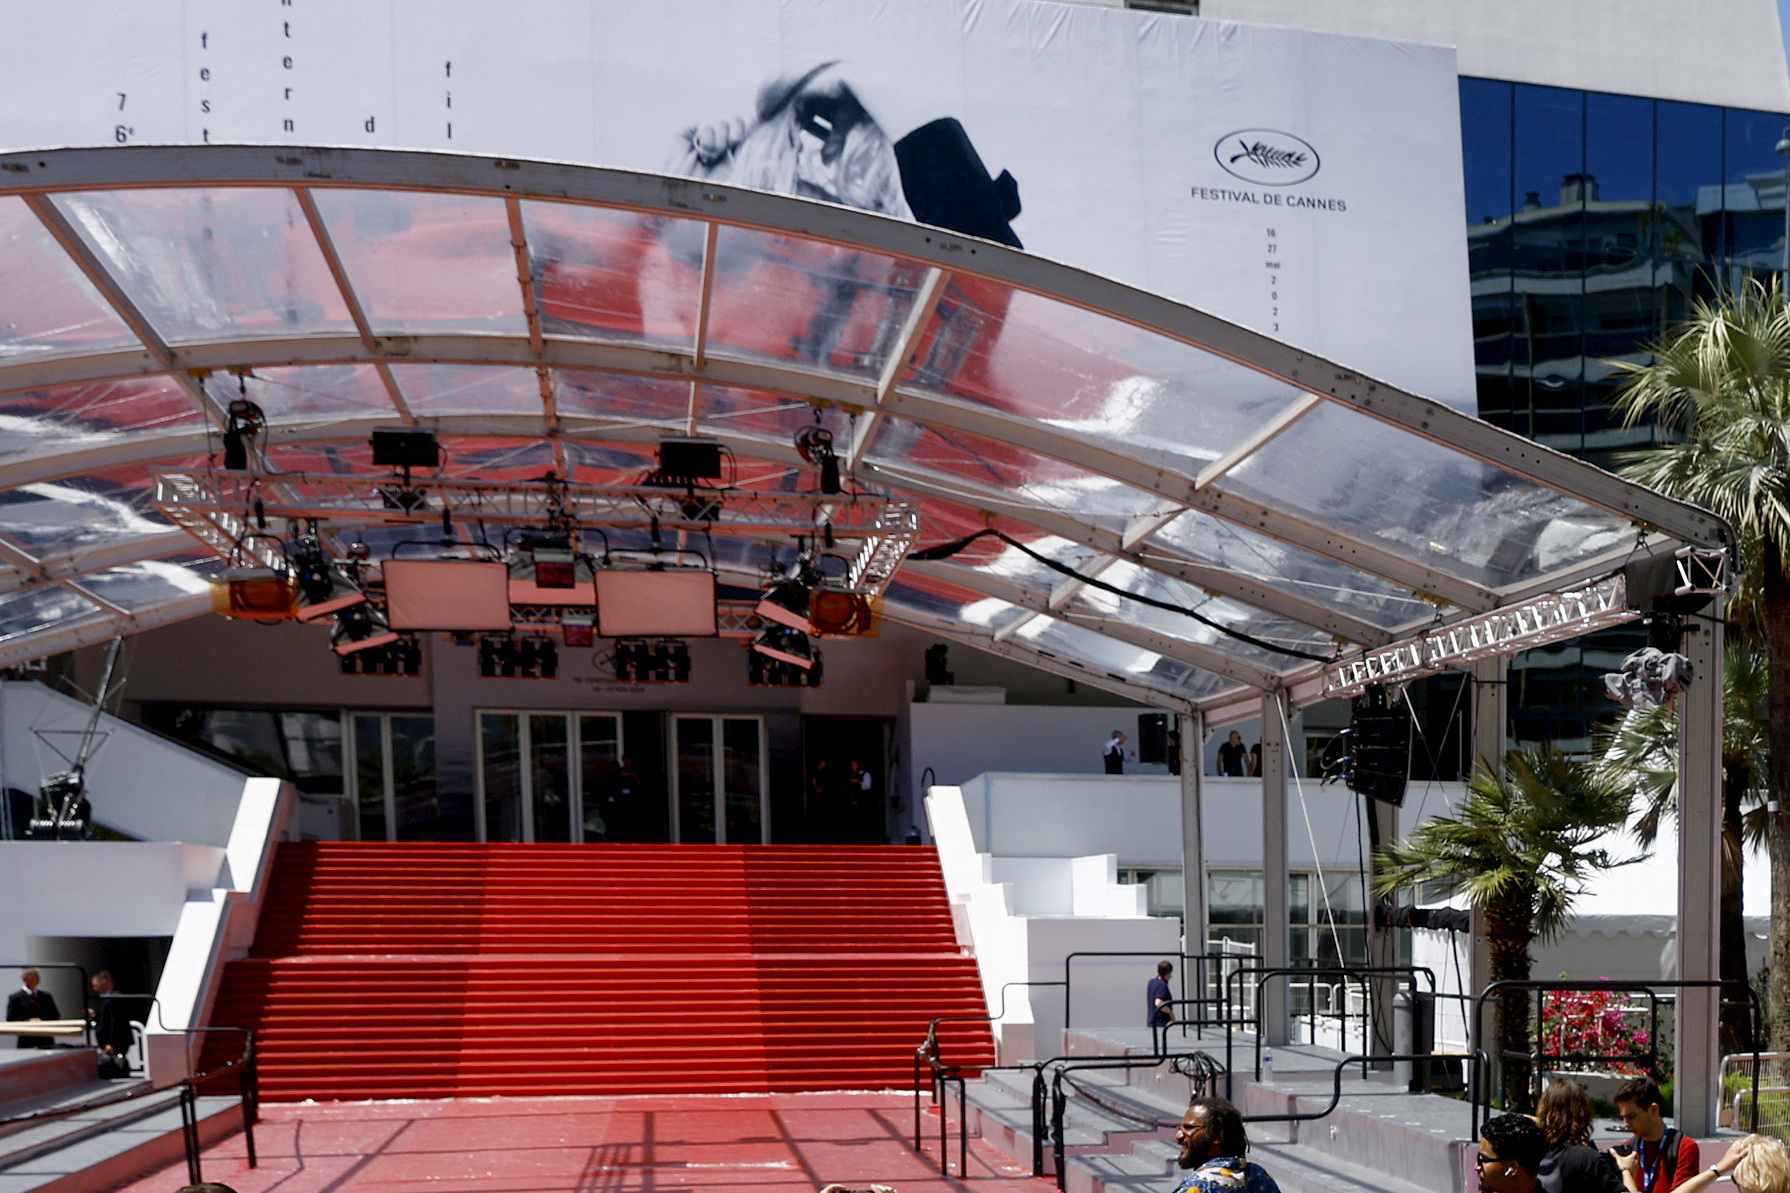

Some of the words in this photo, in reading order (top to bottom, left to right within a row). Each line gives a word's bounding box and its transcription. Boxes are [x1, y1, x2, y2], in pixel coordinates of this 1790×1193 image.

[1191, 186, 1260, 205] FESTIVAL
[1263, 193, 1283, 206] DE
[1286, 196, 1347, 212] CANNES
[1266, 228, 1276, 238] 16
[1267, 244, 1277, 253] 27
[1265, 261, 1280, 270] mai
